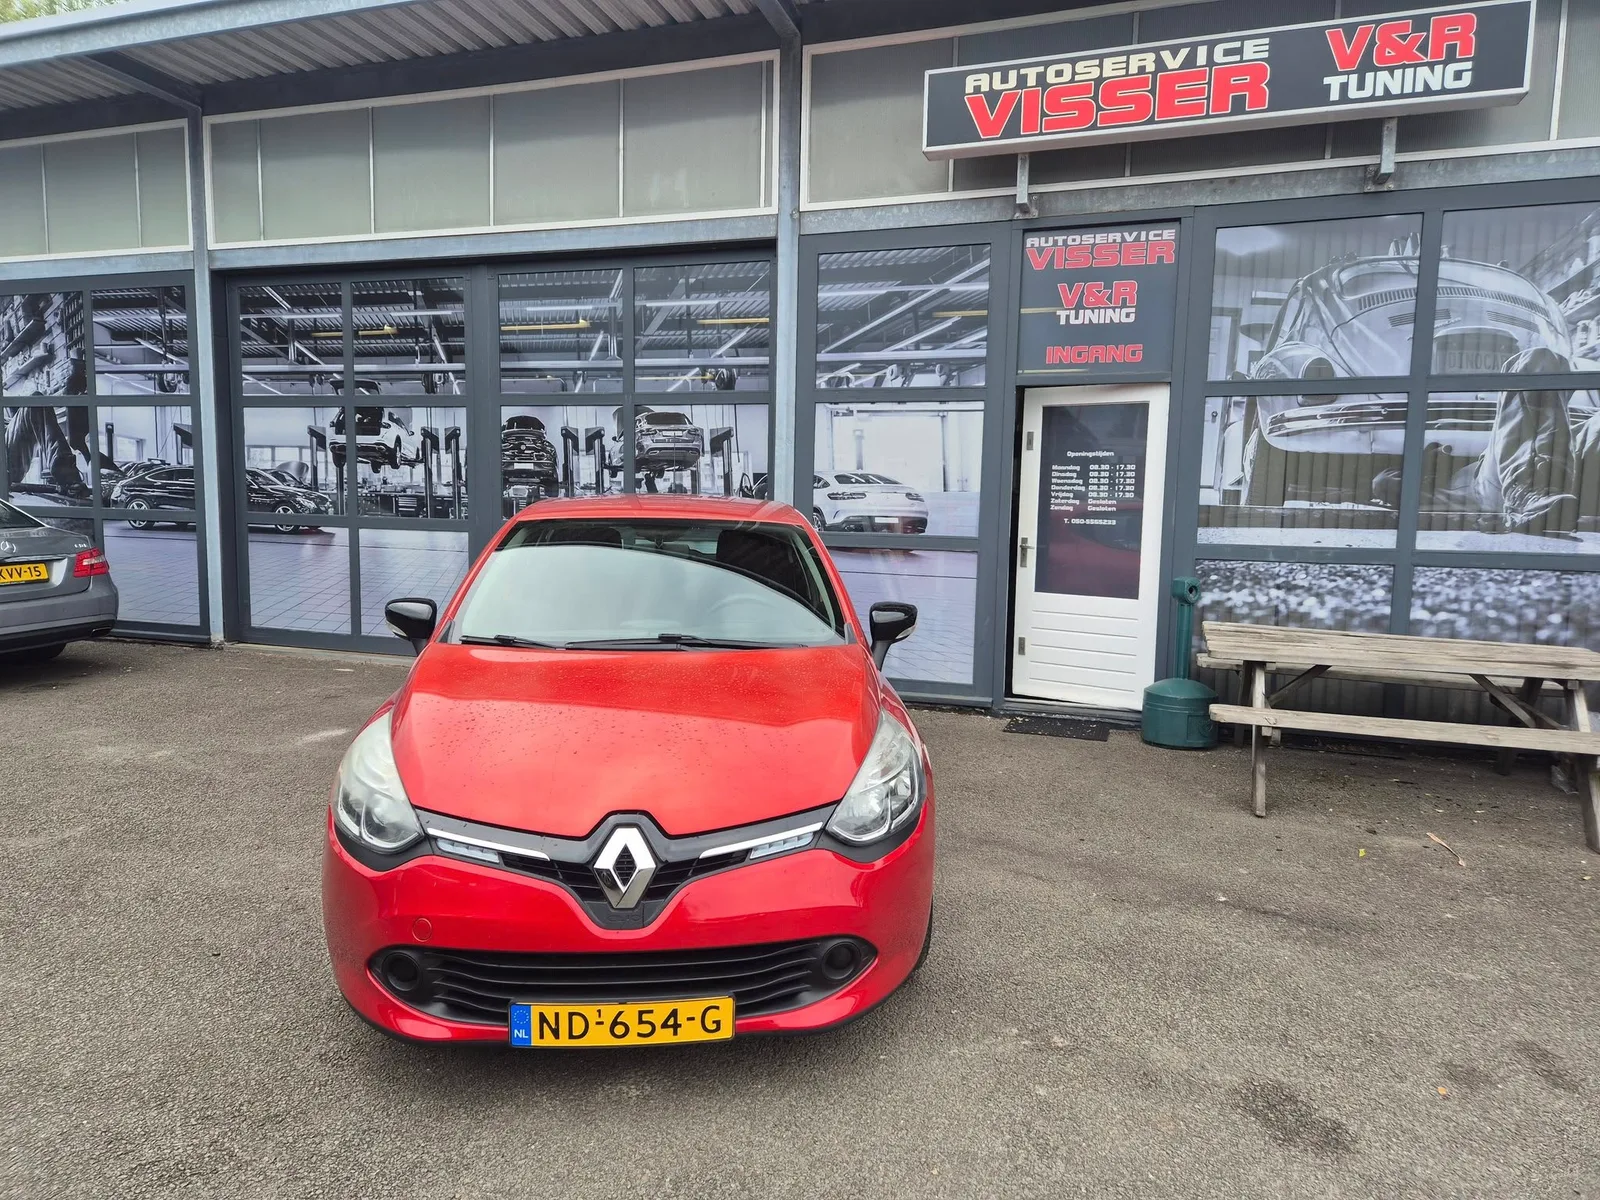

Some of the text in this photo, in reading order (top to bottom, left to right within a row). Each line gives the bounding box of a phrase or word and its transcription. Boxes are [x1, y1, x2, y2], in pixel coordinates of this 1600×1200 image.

[1325, 12, 1477, 71] V&R
[964, 37, 1271, 95] AUTOSERVICE
[1323, 61, 1473, 102] TUNING
[964, 61, 1271, 139] VISSER
[1025, 229, 1176, 248] AUTOSERVICE
[1025, 240, 1176, 271] VISSER
[1057, 280, 1138, 309] V&R
[1056, 307, 1136, 325] TUNING
[1046, 344, 1143, 364] INGANG
[514, 1029, 529, 1039] NL
